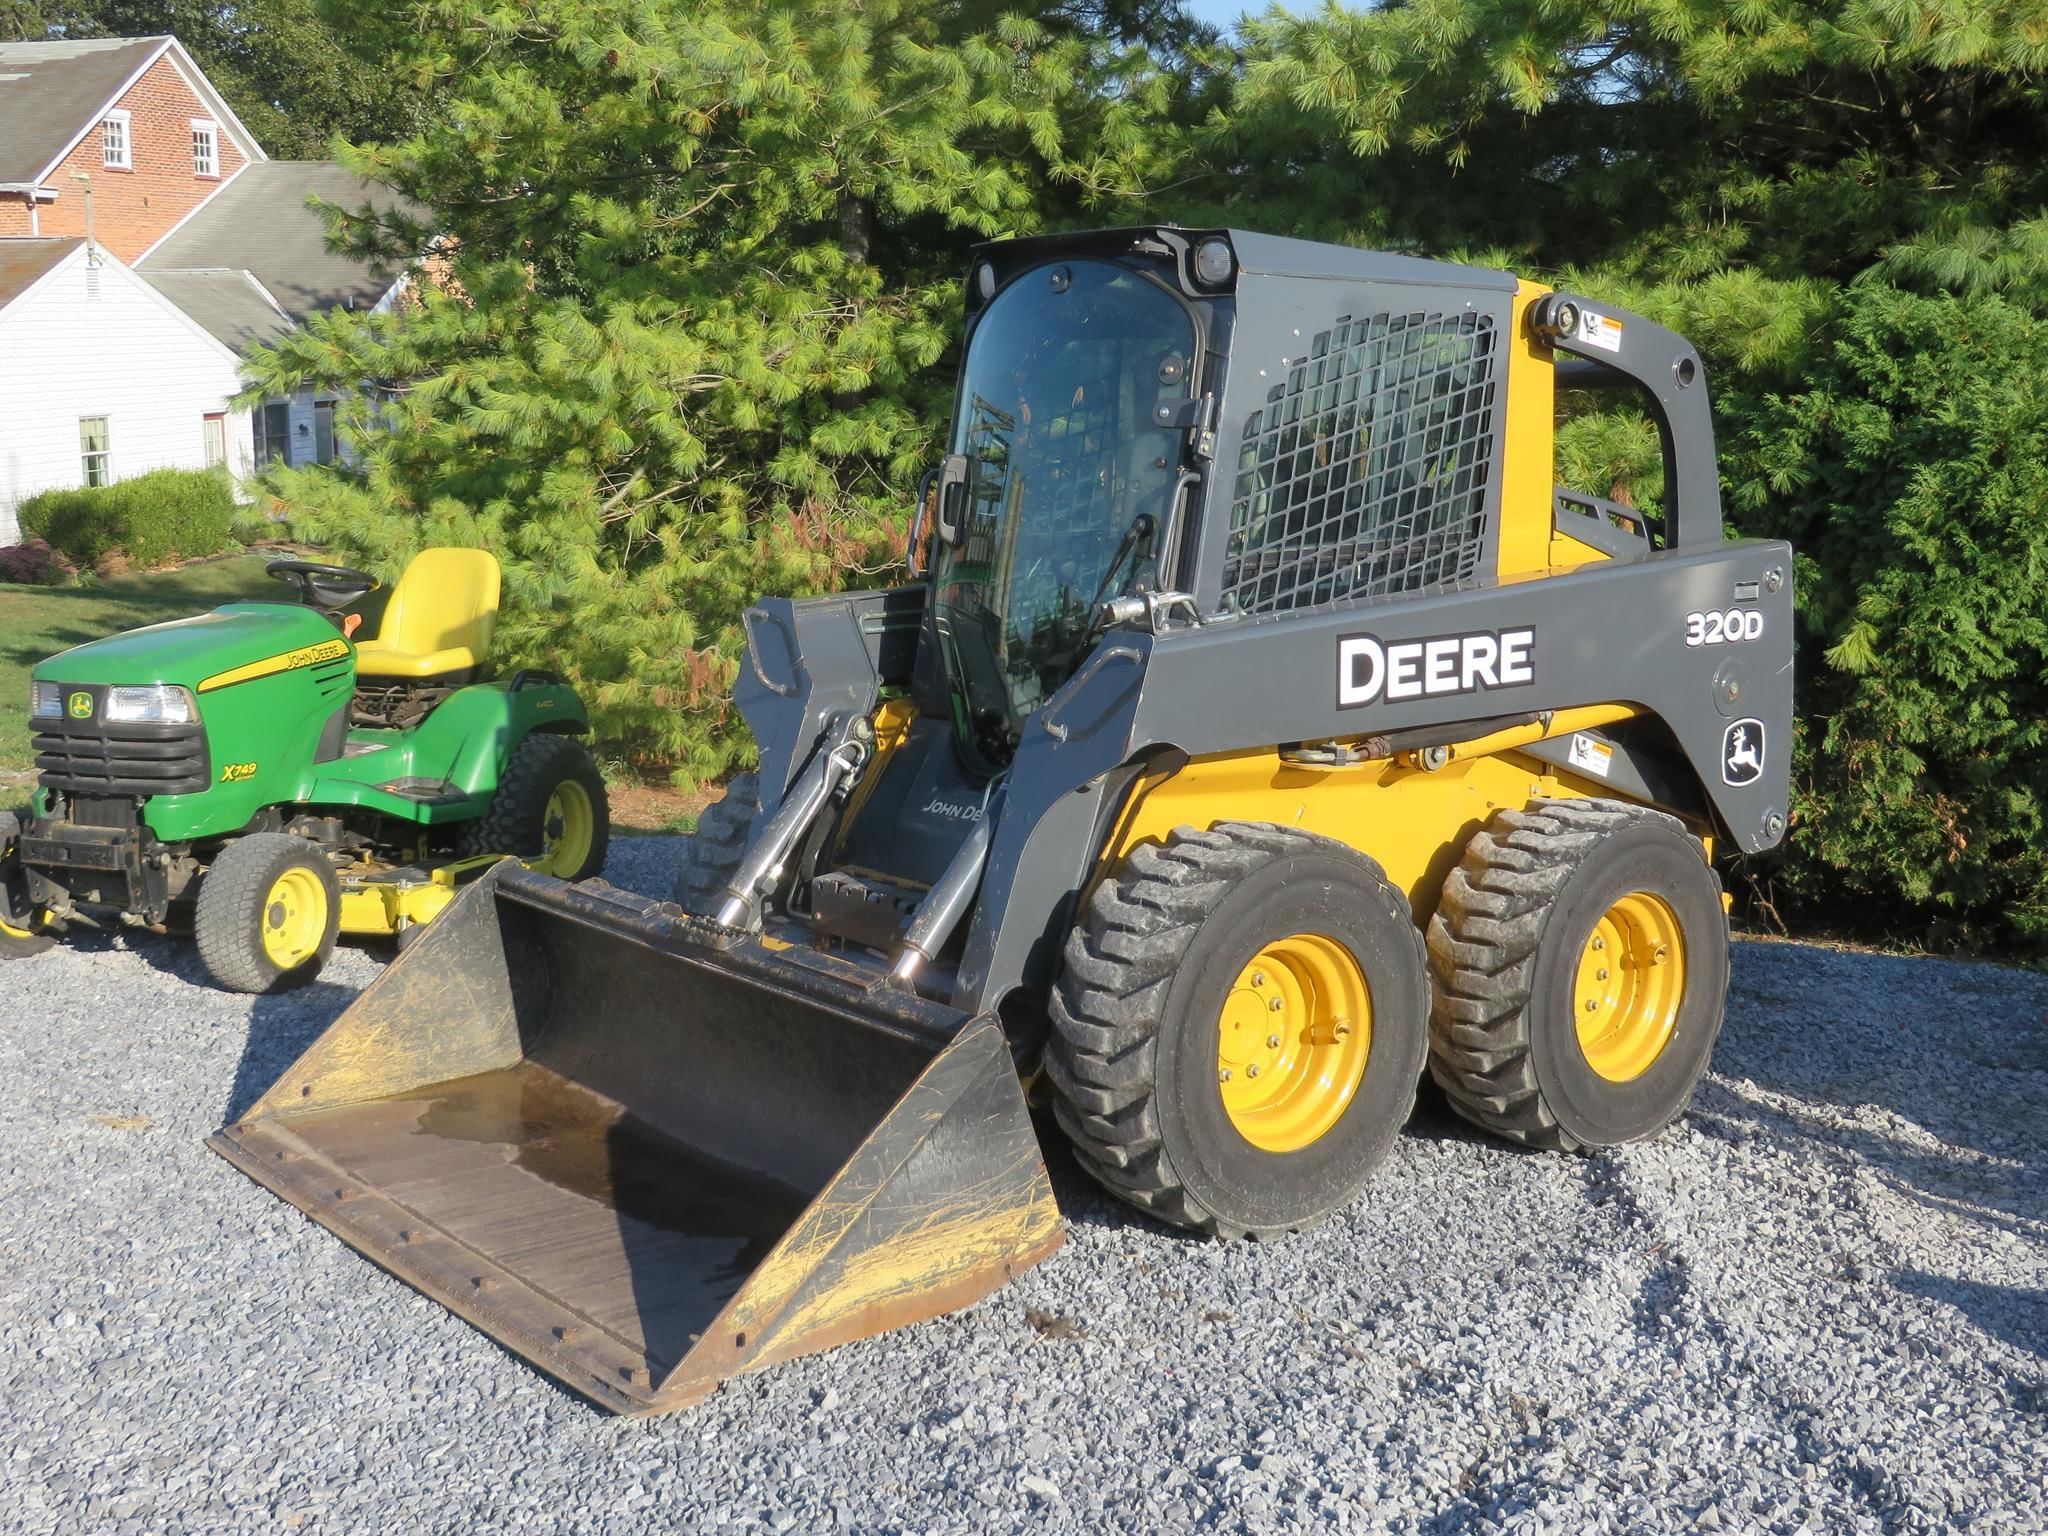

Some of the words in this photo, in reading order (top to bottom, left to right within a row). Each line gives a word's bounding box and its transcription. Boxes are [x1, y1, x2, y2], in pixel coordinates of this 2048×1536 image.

[1685, 608, 1763, 647] 320D
[287, 651, 312, 668] JOHN
[311, 645, 340, 661] DEERE
[1338, 628, 1535, 707] DEERE
[220, 762, 257, 782] X749
[922, 799, 963, 818] JOHN
[960, 805, 984, 822] DE
